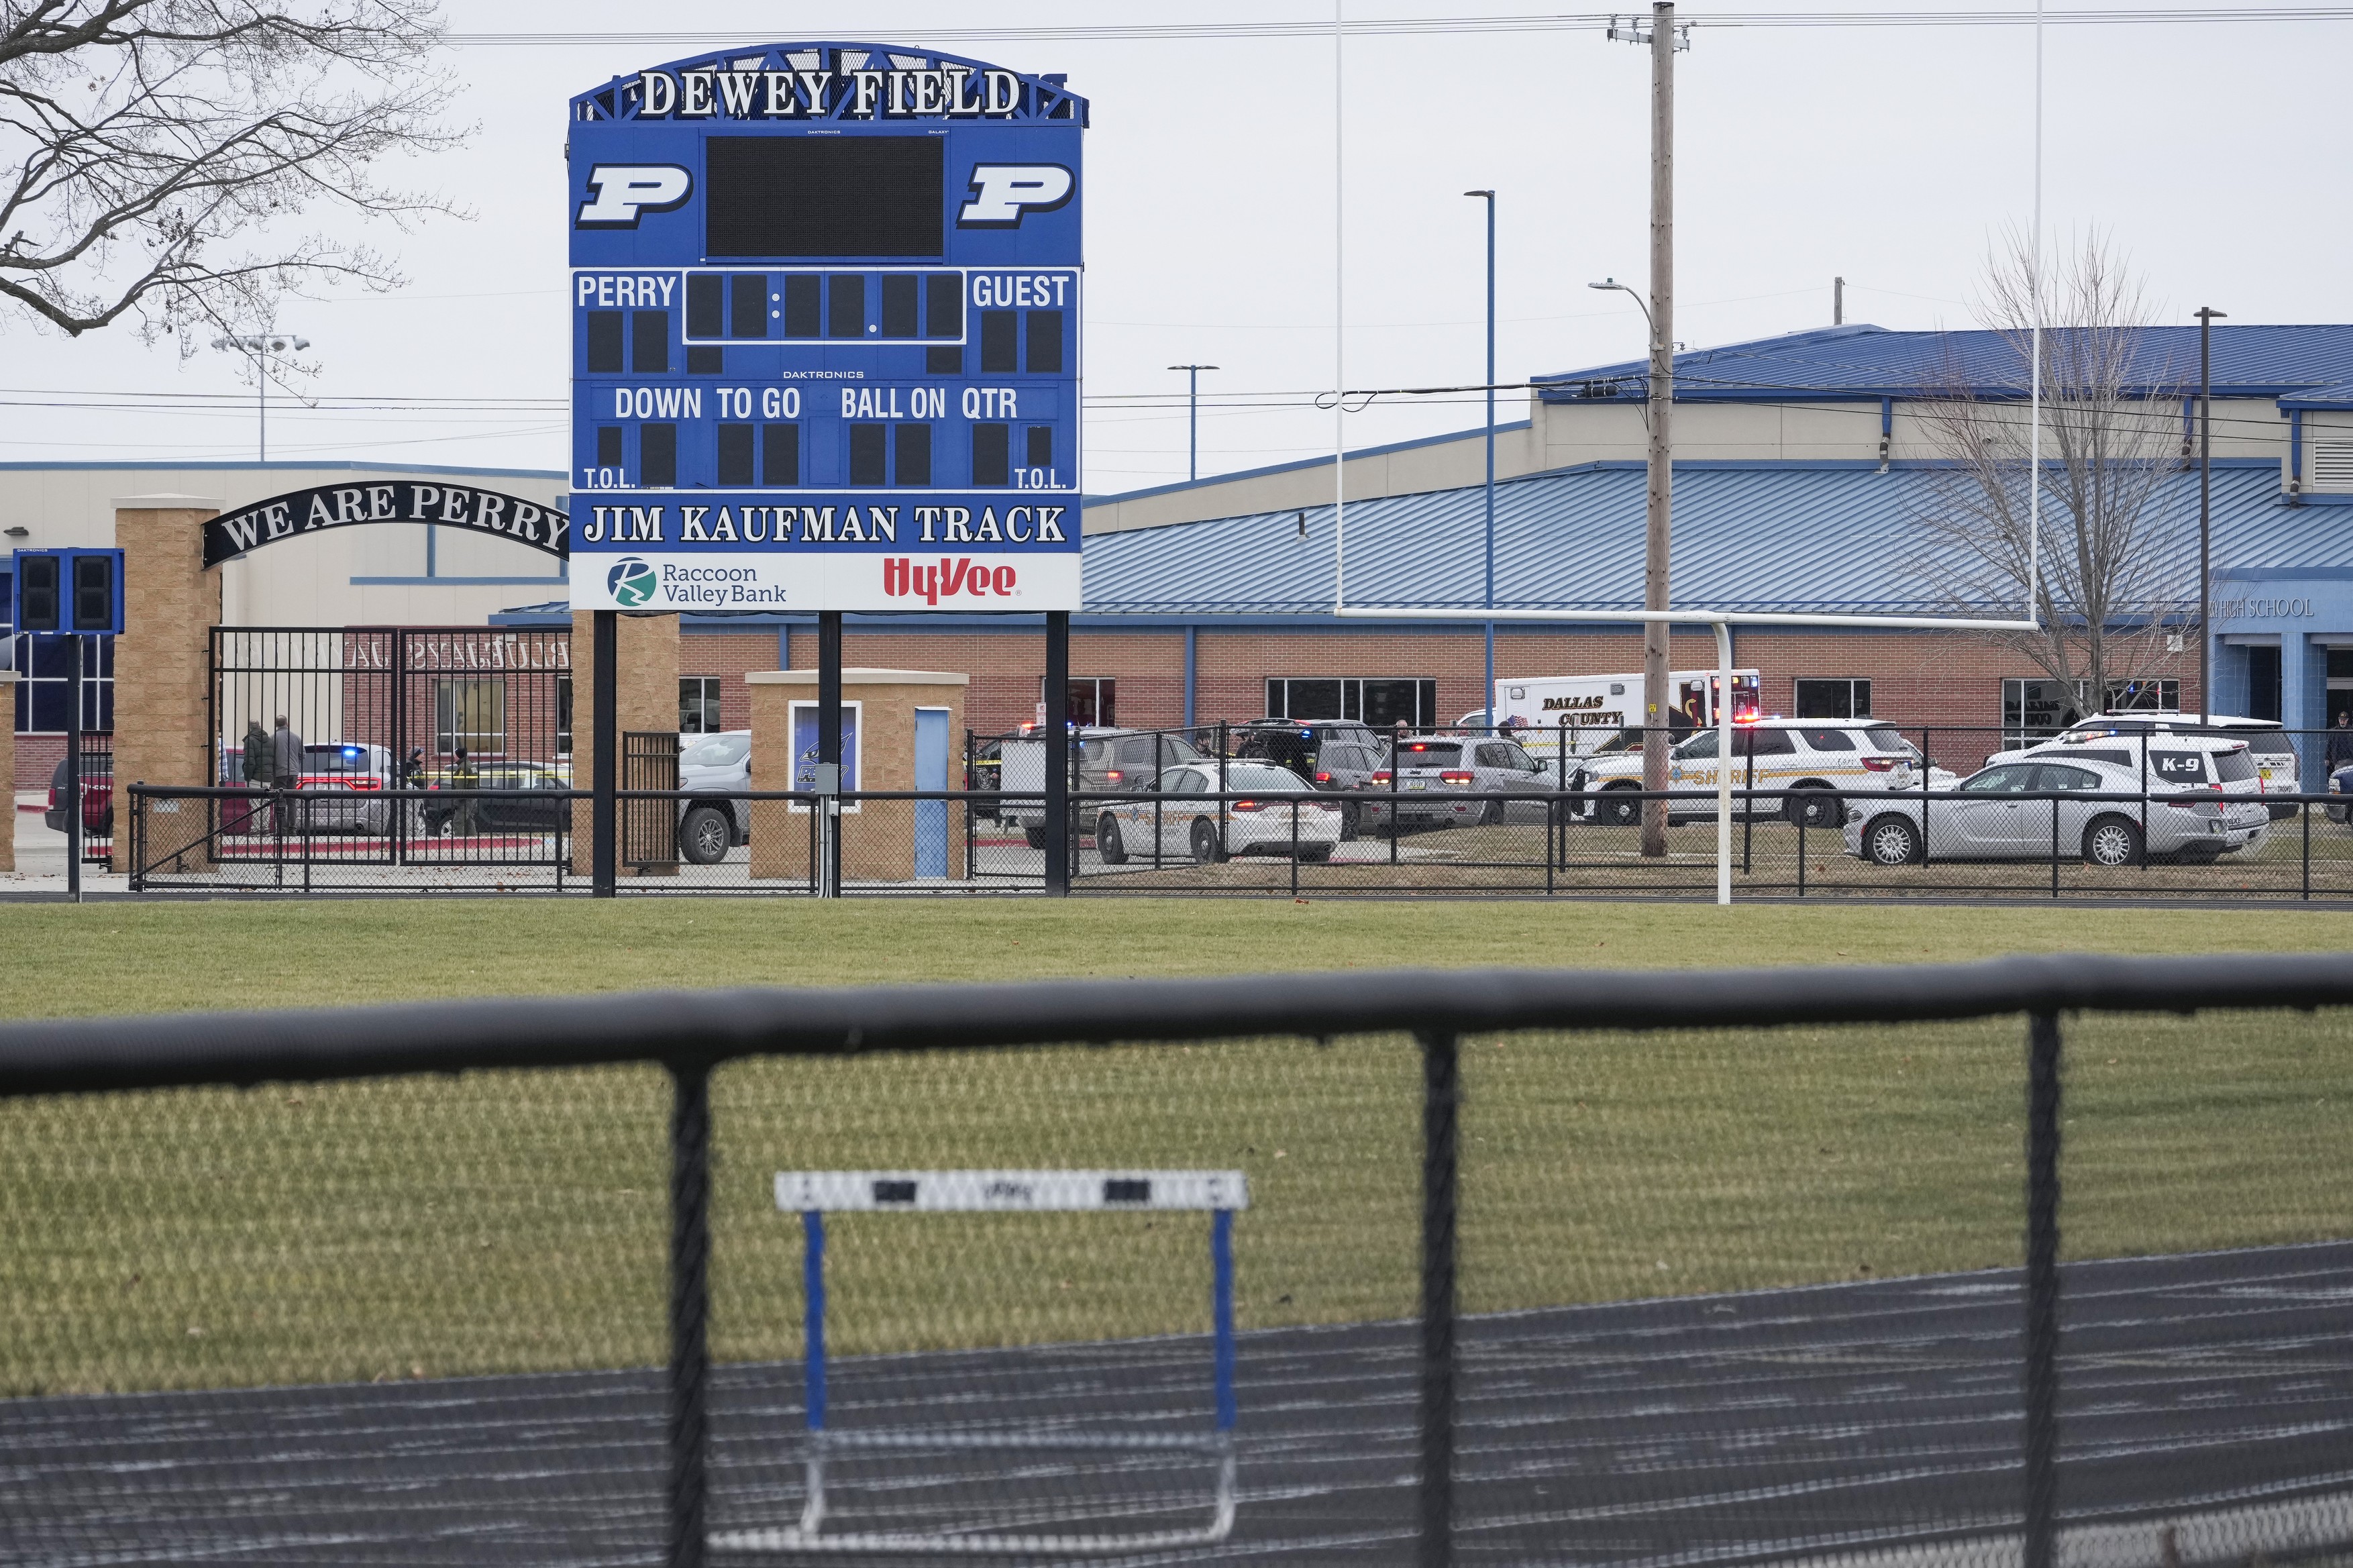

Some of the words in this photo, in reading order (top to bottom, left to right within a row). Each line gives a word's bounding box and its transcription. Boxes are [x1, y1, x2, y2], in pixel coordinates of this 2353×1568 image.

[640, 70, 832, 115] DEWEY
[853, 70, 1021, 115] FIELD
[576, 163, 693, 229] P
[957, 163, 1075, 229] P
[578, 276, 676, 307] PERRY
[972, 276, 1069, 307] GUEST
[783, 370, 864, 379] DAKTRONICS
[615, 388, 700, 419] DOWN
[717, 388, 757, 419] TO
[762, 387, 800, 419] GO
[842, 388, 903, 419] BALL
[910, 387, 945, 419] ON
[962, 387, 1016, 419] QTR
[584, 468, 635, 488] T.O.L.
[1014, 468, 1066, 488] T.O.L.
[221, 501, 294, 552] WE
[305, 485, 396, 530] ARE
[409, 485, 569, 551] PERRY
[584, 505, 664, 543] JIM
[680, 505, 899, 543] KAUFMAN
[915, 505, 1065, 543] TRACK
[663, 564, 757, 581] Raccoon
[663, 585, 728, 607] Valley
[731, 585, 786, 602] Bank
[2221, 600, 2245, 617] HIGH
[2249, 598, 2314, 617] SCHOOL
[1542, 696, 1604, 710] DALLAS
[2162, 757, 2199, 772] K-9
[1693, 769, 1769, 785] SHRIFF
